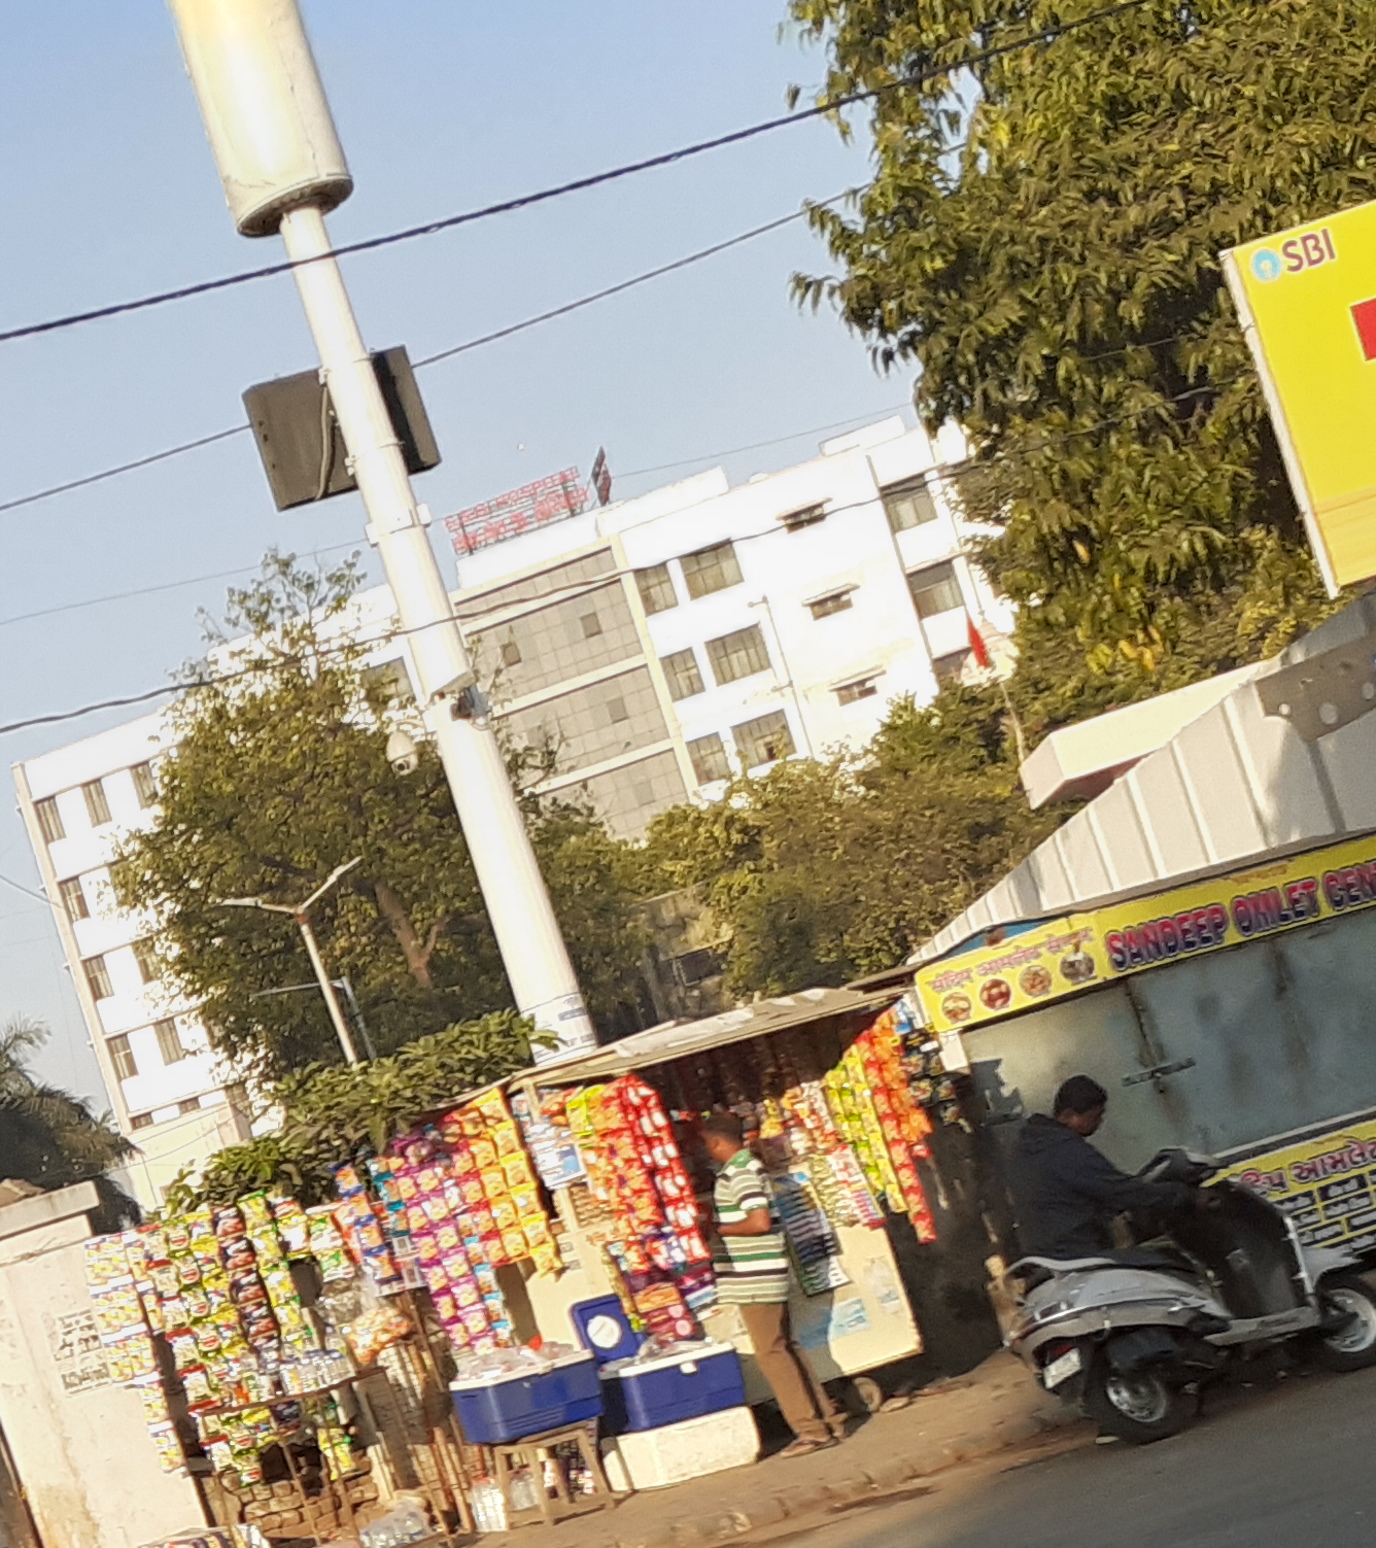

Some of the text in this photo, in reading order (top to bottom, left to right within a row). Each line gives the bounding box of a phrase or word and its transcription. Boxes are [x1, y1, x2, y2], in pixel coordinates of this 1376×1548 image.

[1281, 228, 1336, 273] SBI
[1105, 902, 1230, 972] SANDEEP
[1231, 876, 1321, 937] OMLET
